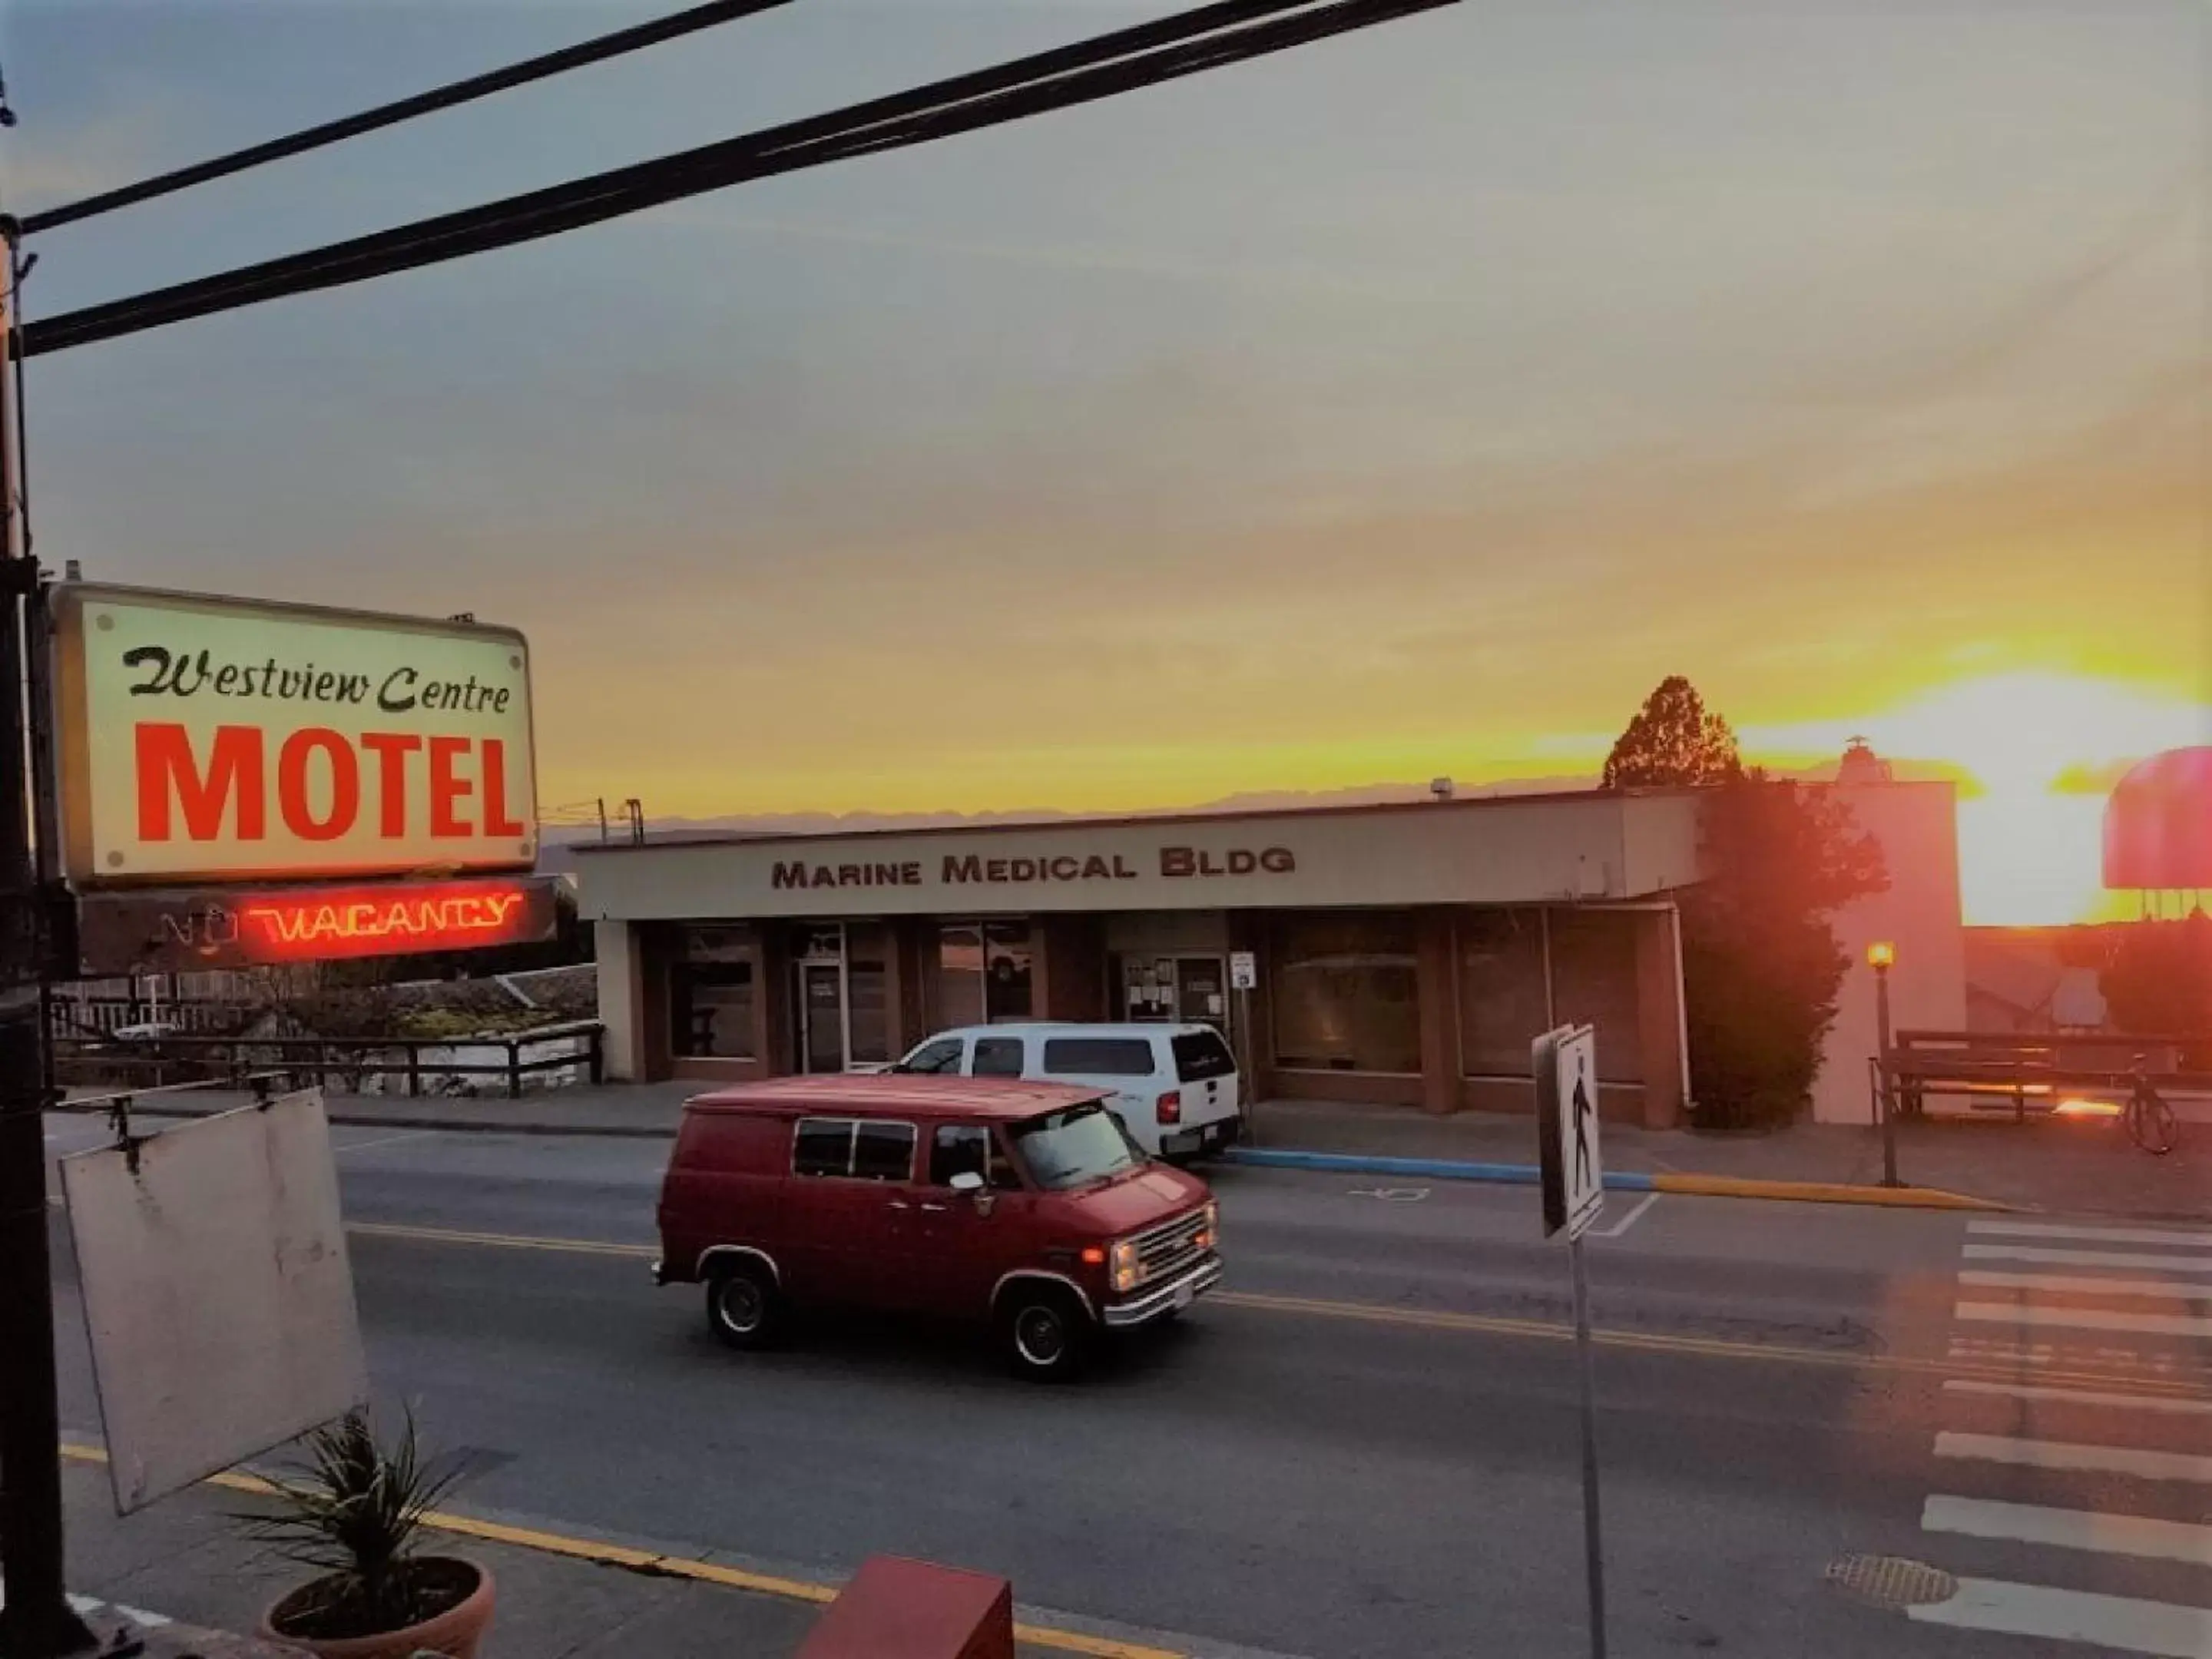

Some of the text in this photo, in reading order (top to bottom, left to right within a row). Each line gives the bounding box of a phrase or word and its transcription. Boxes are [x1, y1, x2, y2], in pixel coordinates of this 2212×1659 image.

[123, 645, 511, 714] Westview Centre
[134, 722, 525, 842] MOTEL
[771, 846, 1296, 889] MARINE MEDICAL BLDG
[158, 892, 524, 945] NO VACANCY
